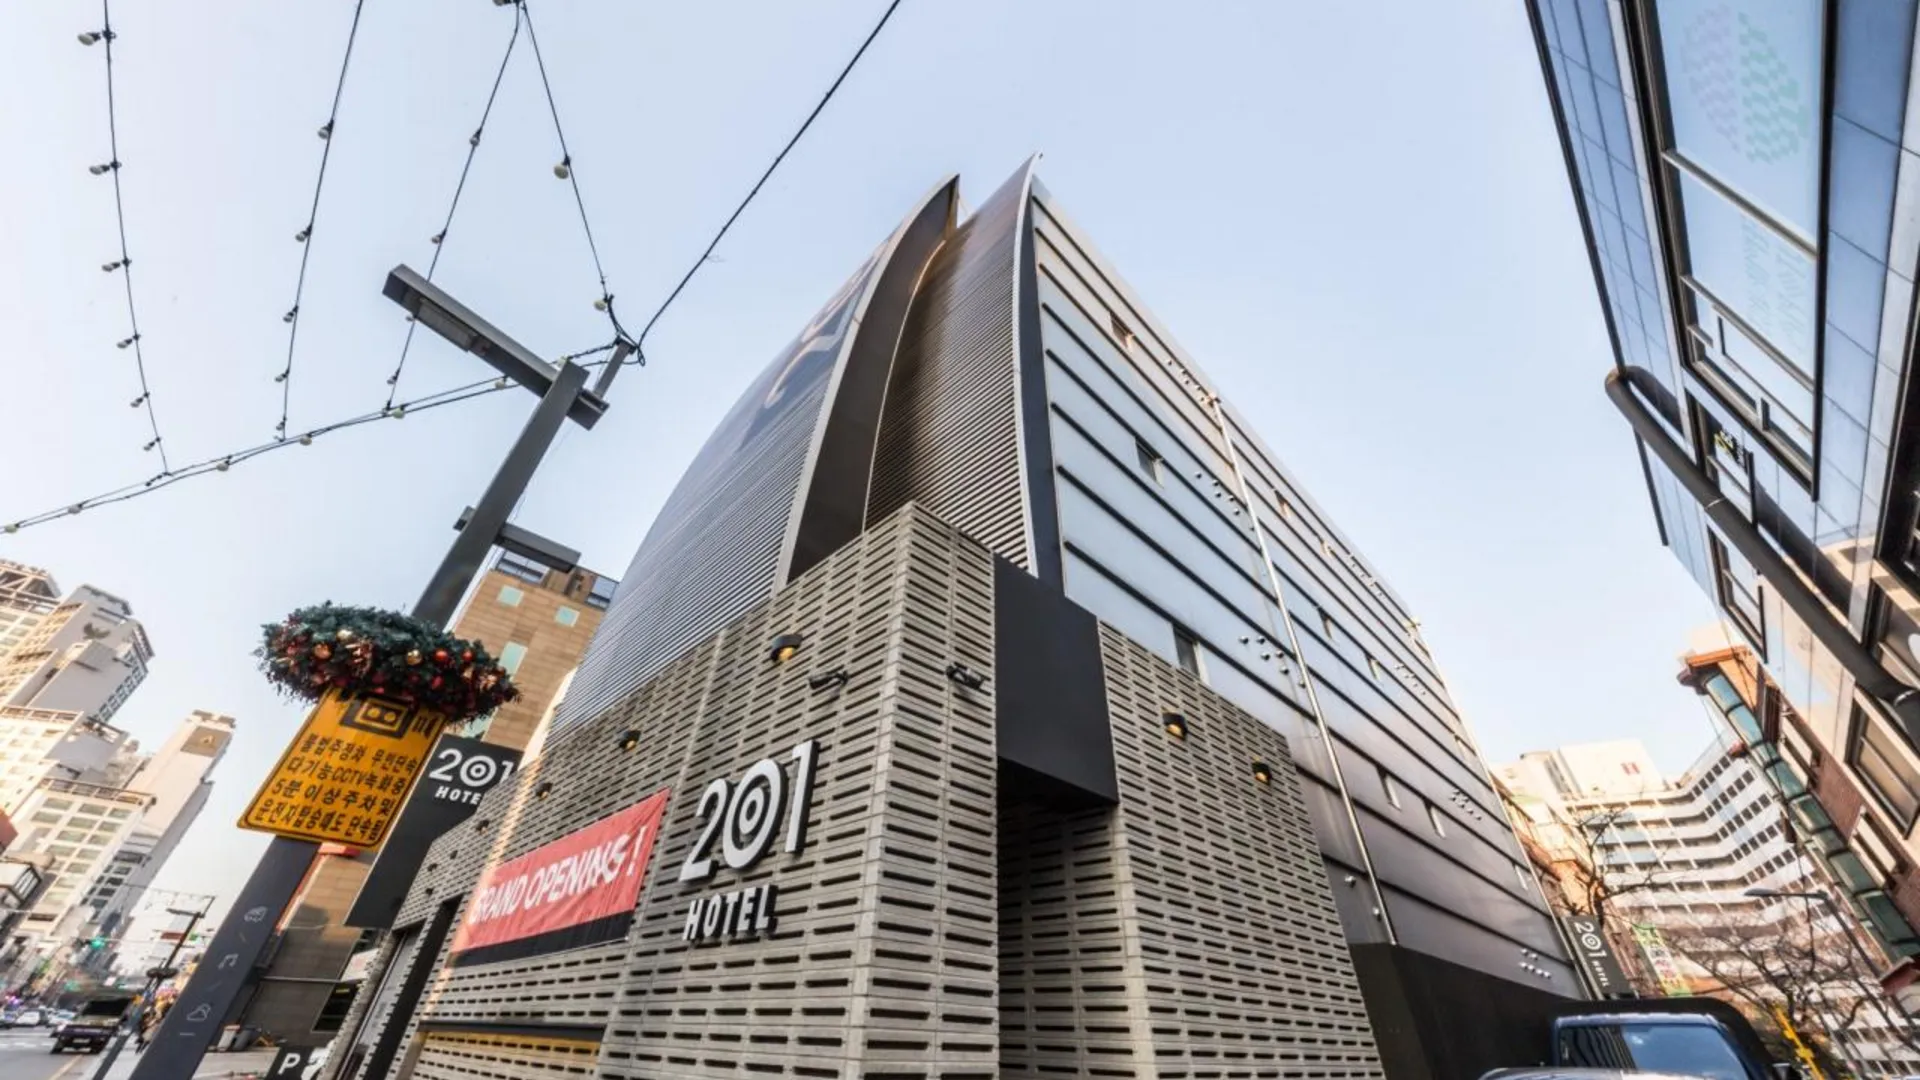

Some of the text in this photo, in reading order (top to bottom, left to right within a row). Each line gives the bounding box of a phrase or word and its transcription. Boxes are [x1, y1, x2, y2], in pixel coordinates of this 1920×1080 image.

[429, 748, 514, 787] 201
[271, 778, 302, 799] 5분
[434, 785, 482, 805] HOTE
[679, 739, 819, 882] 201
[468, 873, 529, 925] GRAND
[682, 884, 777, 941] HOTEL
[1573, 921, 1608, 958] 201
[277, 1052, 301, 1075] P
